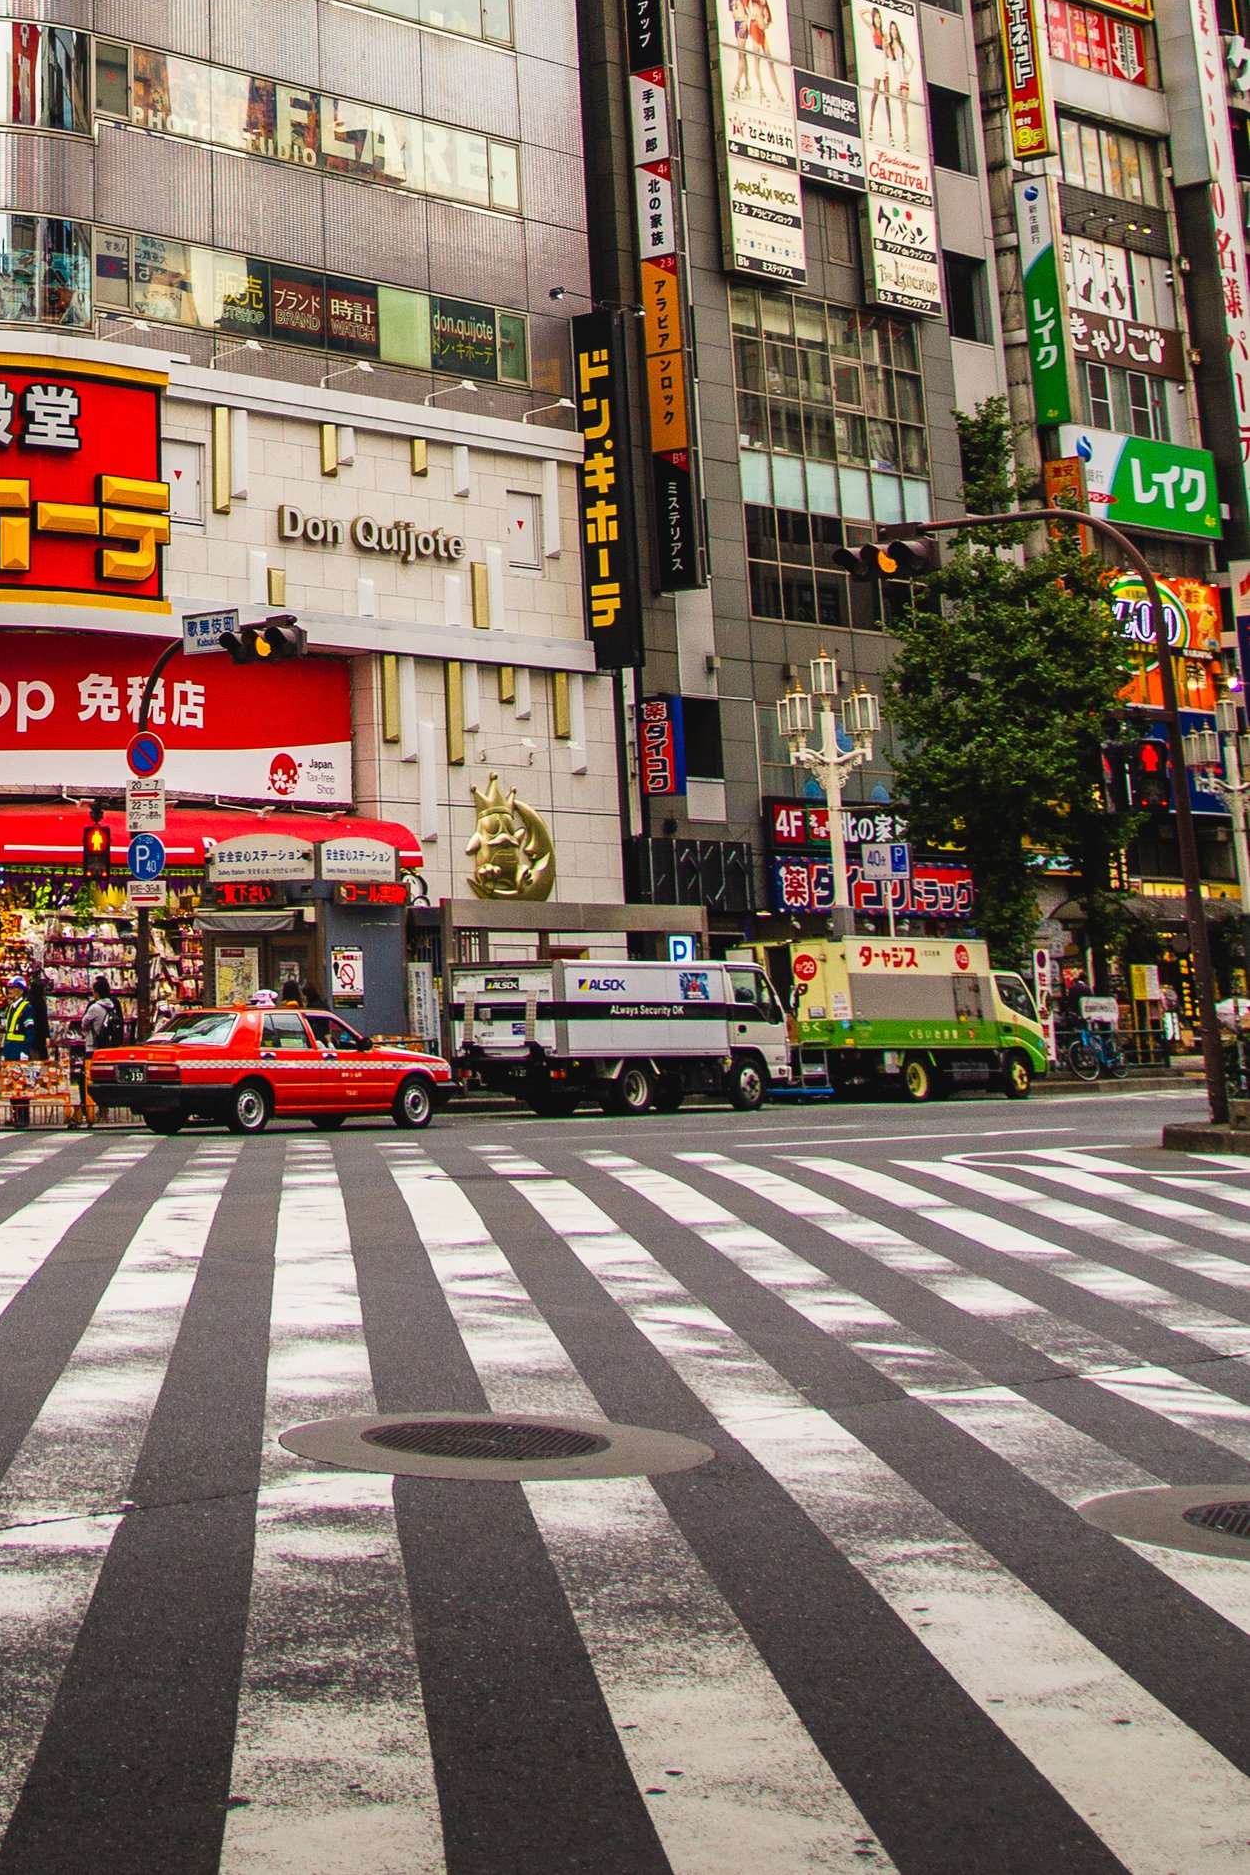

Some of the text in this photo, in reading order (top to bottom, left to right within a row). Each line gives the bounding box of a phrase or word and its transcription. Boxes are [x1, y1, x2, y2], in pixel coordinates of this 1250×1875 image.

[822, 92, 857, 114] PARTNERS
[822, 105, 850, 122] DINING
[642, 88, 658, 153] 手羽一郎
[275, 82, 490, 195] FLARE
[748, 124, 794, 150] ひとめぼれ
[869, 160, 929, 192] Carnival
[648, 179, 664, 247] 北の家族
[214, 269, 265, 309] 販売
[273, 288, 322, 316] ブランド
[330, 298, 376, 325] 時計
[275, 308, 321, 332] BRAND
[330, 317, 376, 342] WATCH
[432, 311, 494, 342] don.quijote
[1033, 298, 1058, 371] レイク
[1130, 457, 1207, 513] レイク
[279, 504, 467, 564] Don Quijote
[666, 481, 684, 572] ミステリアス
[187, 615, 235, 638] 歌舞伎町
[77, 673, 206, 729] 免税店
[308, 758, 335, 770] Japan.
[306, 772, 335, 783] Tax-free
[316, 784, 336, 796] Shop
[776, 809, 802, 838] 4F
[135, 844, 150, 874] P
[218, 849, 304, 863] 安全安心ステーション
[326, 848, 391, 862] 安全安心ステーション
[894, 847, 904, 861] P
[145, 861, 157, 873] 40
[673, 936, 688, 960] P
[491, 980, 519, 991] ALSOK
[588, 979, 627, 991] ALSOK
[639, 1005, 672, 1017] Security
[672, 1005, 684, 1015] OK
